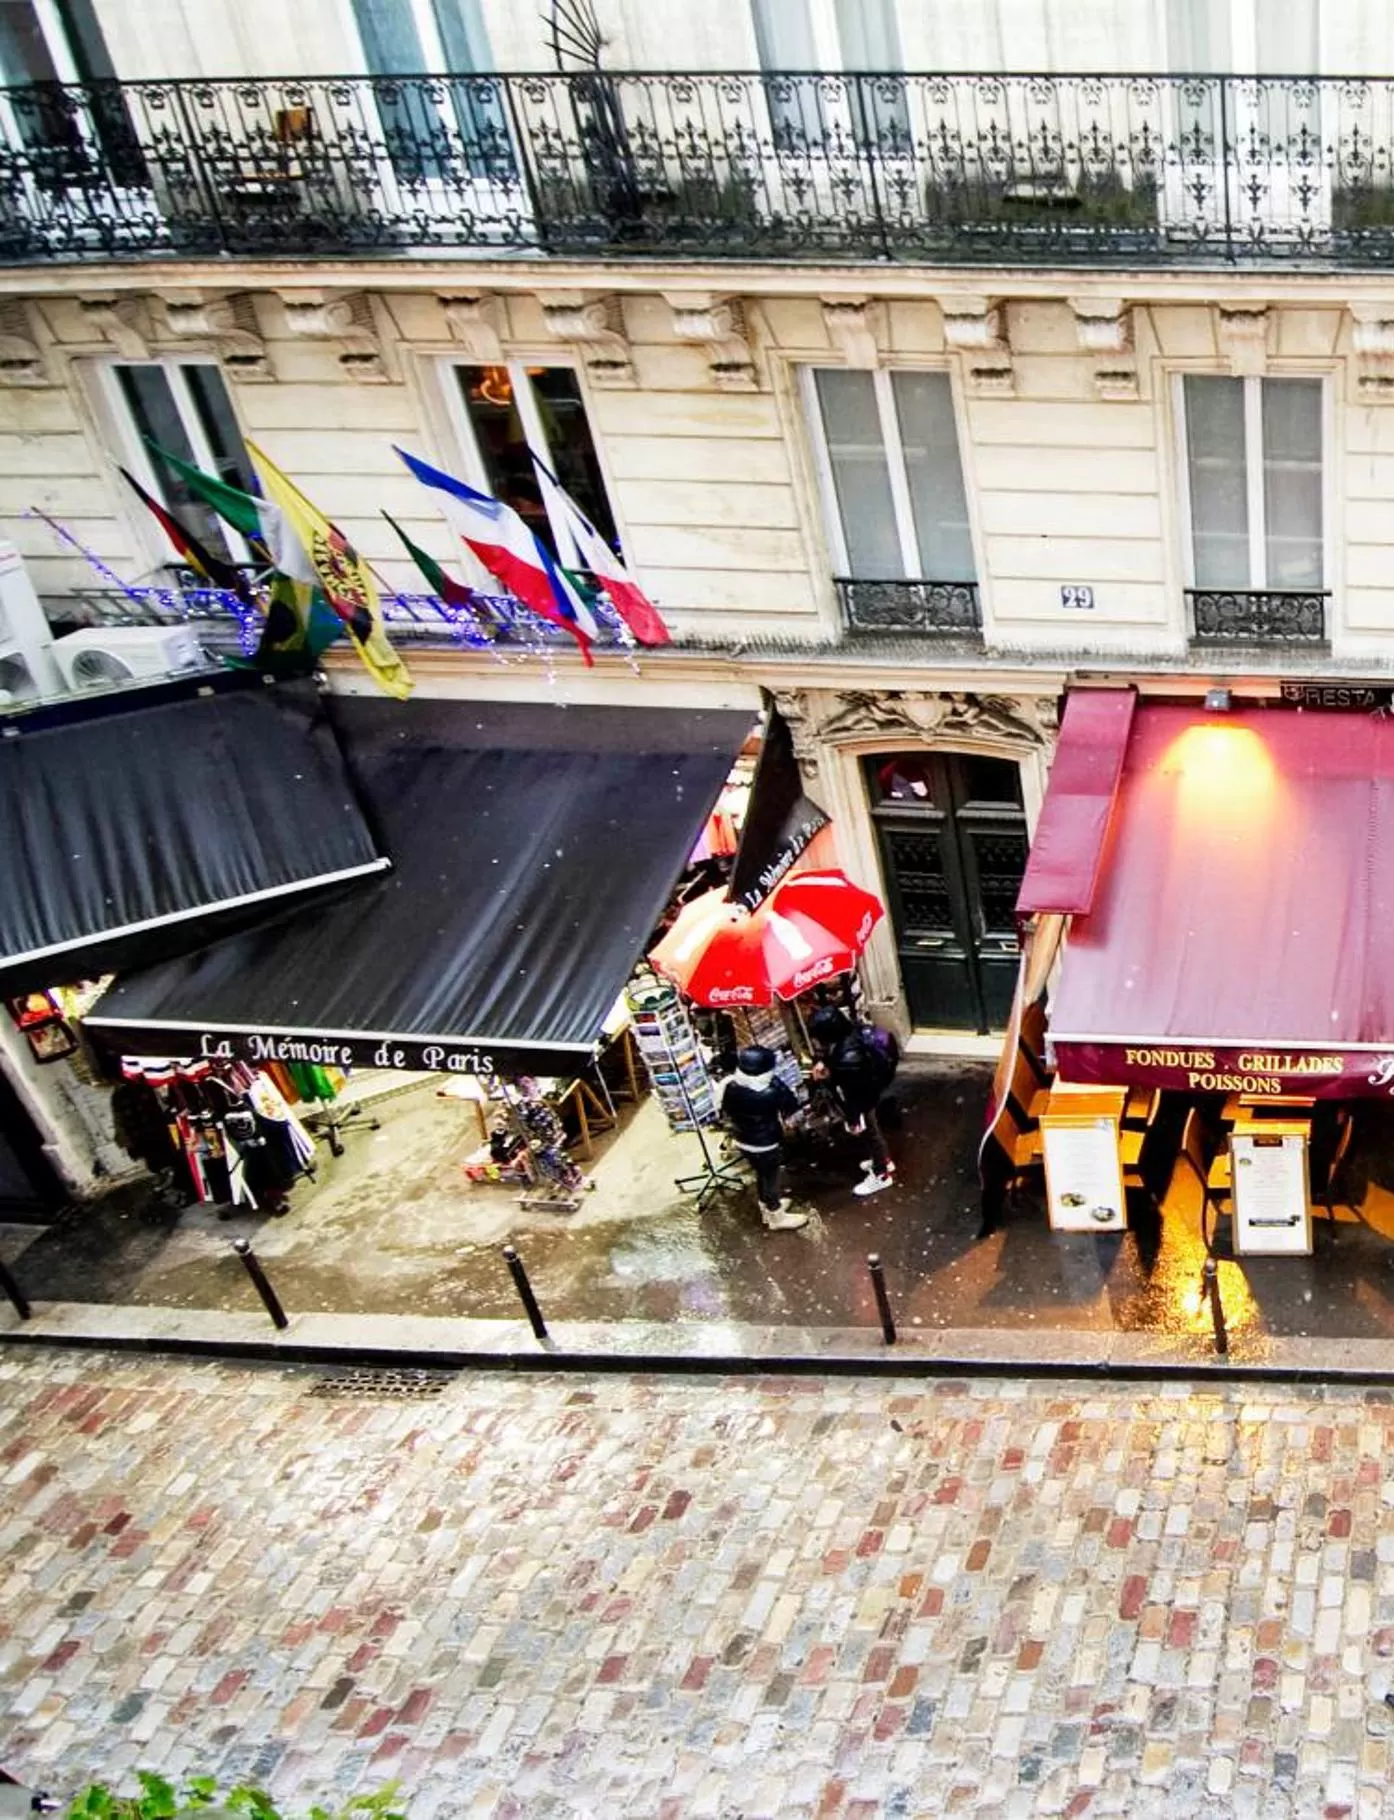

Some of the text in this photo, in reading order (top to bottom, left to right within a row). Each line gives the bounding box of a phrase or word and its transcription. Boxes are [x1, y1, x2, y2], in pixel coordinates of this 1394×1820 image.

[1062, 586, 1092, 608] 29
[200, 1034, 494, 1074] La Mémoire de Paris
[1125, 1050, 1344, 1073] FONDUES GRILLADES
[1189, 1071, 1281, 1094] POISSONS
